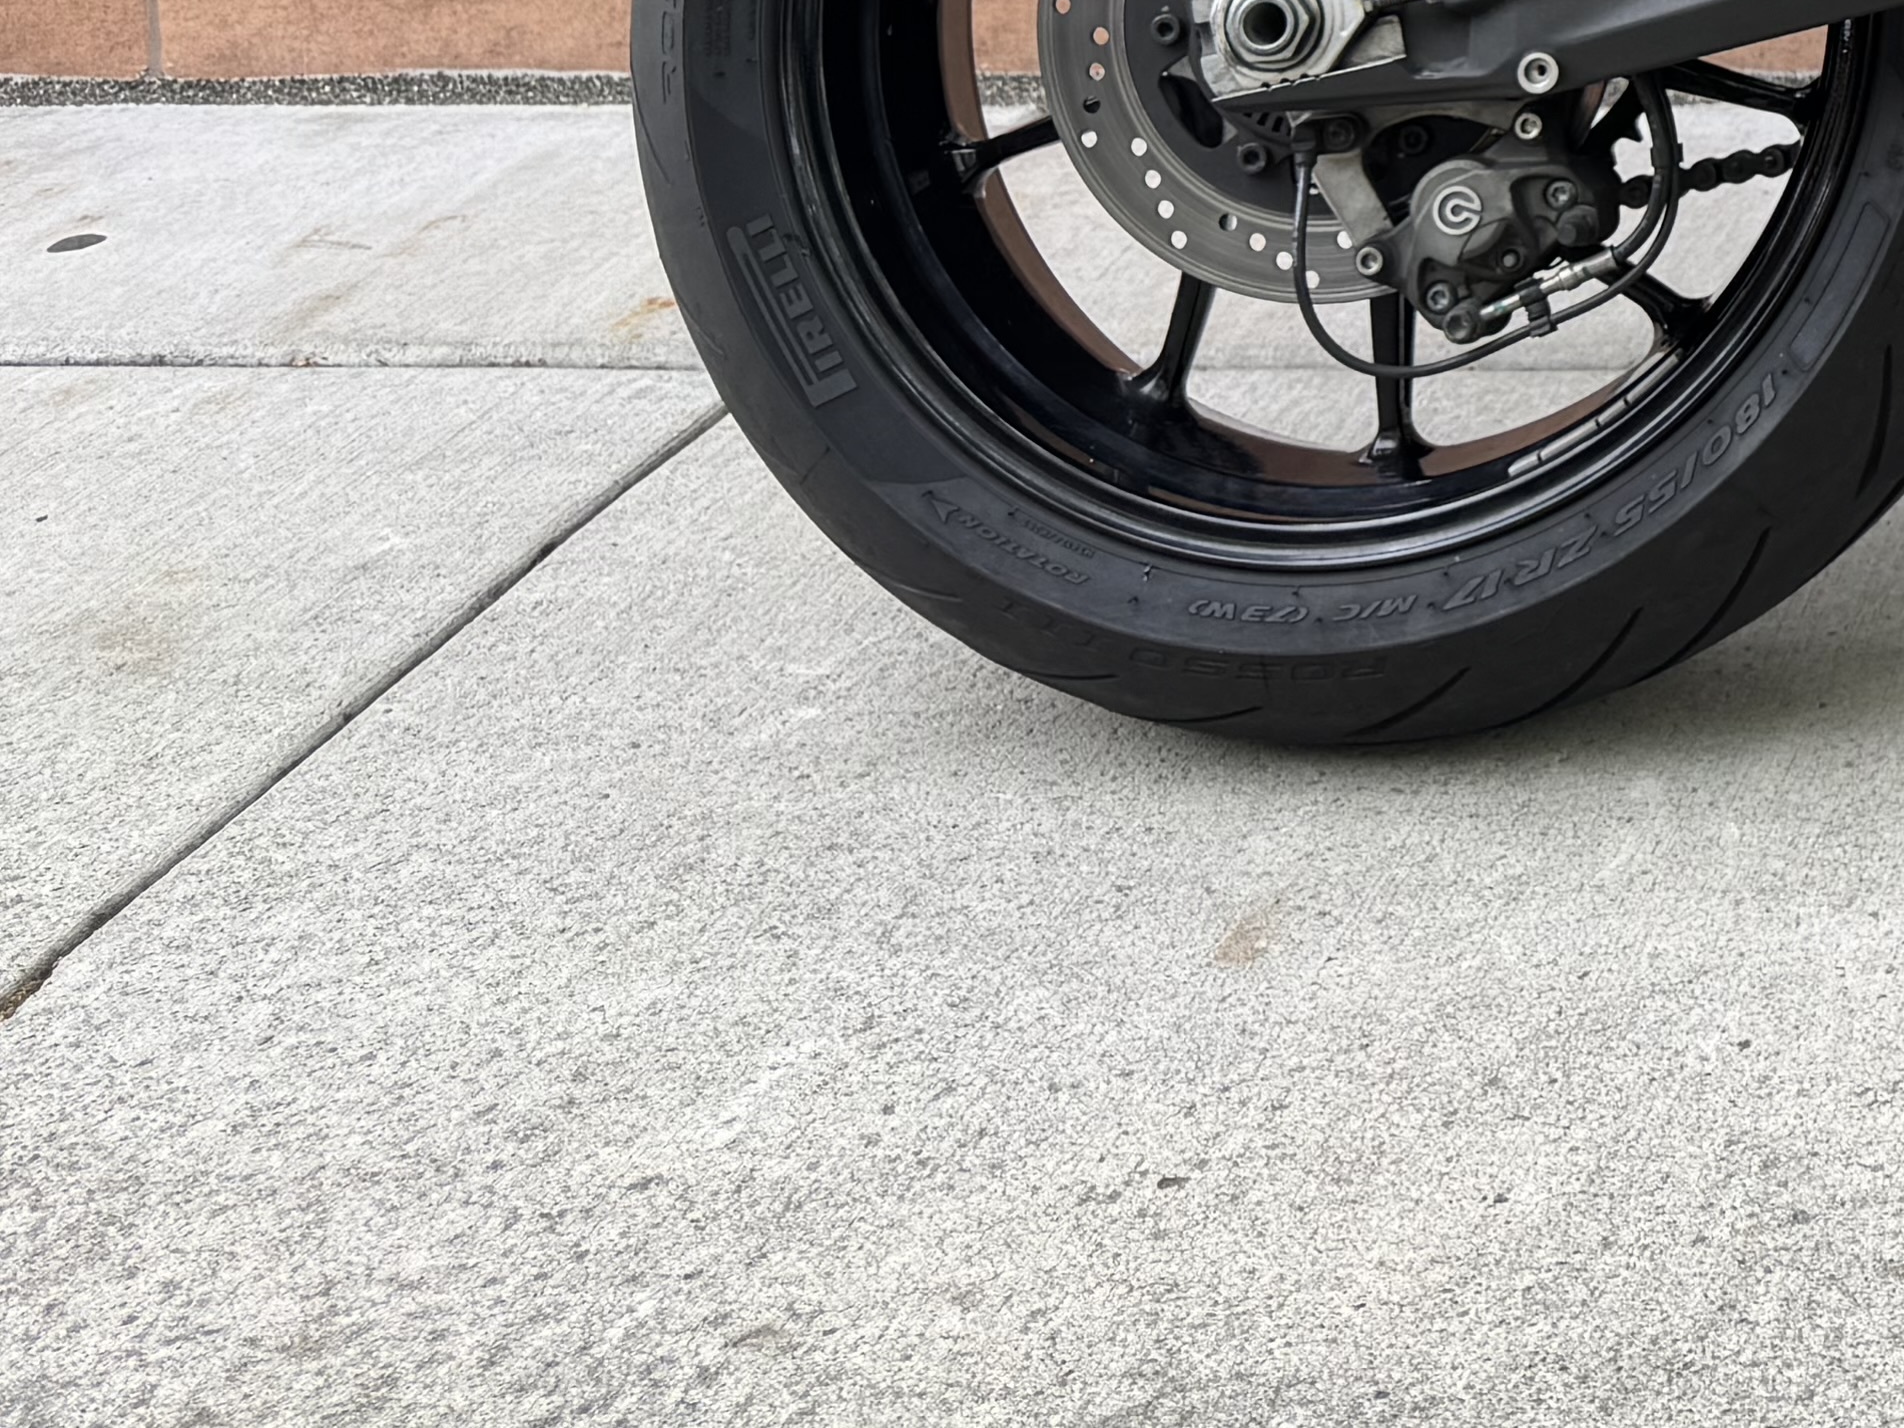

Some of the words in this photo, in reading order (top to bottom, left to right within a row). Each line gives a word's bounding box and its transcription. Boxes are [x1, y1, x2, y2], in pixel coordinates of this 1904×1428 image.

[726, 214, 858, 408] PIRELLI
[1613, 372, 1777, 537] 180/55
[958, 514, 1090, 585] ROTATION
[1331, 593, 1418, 622] M/C
